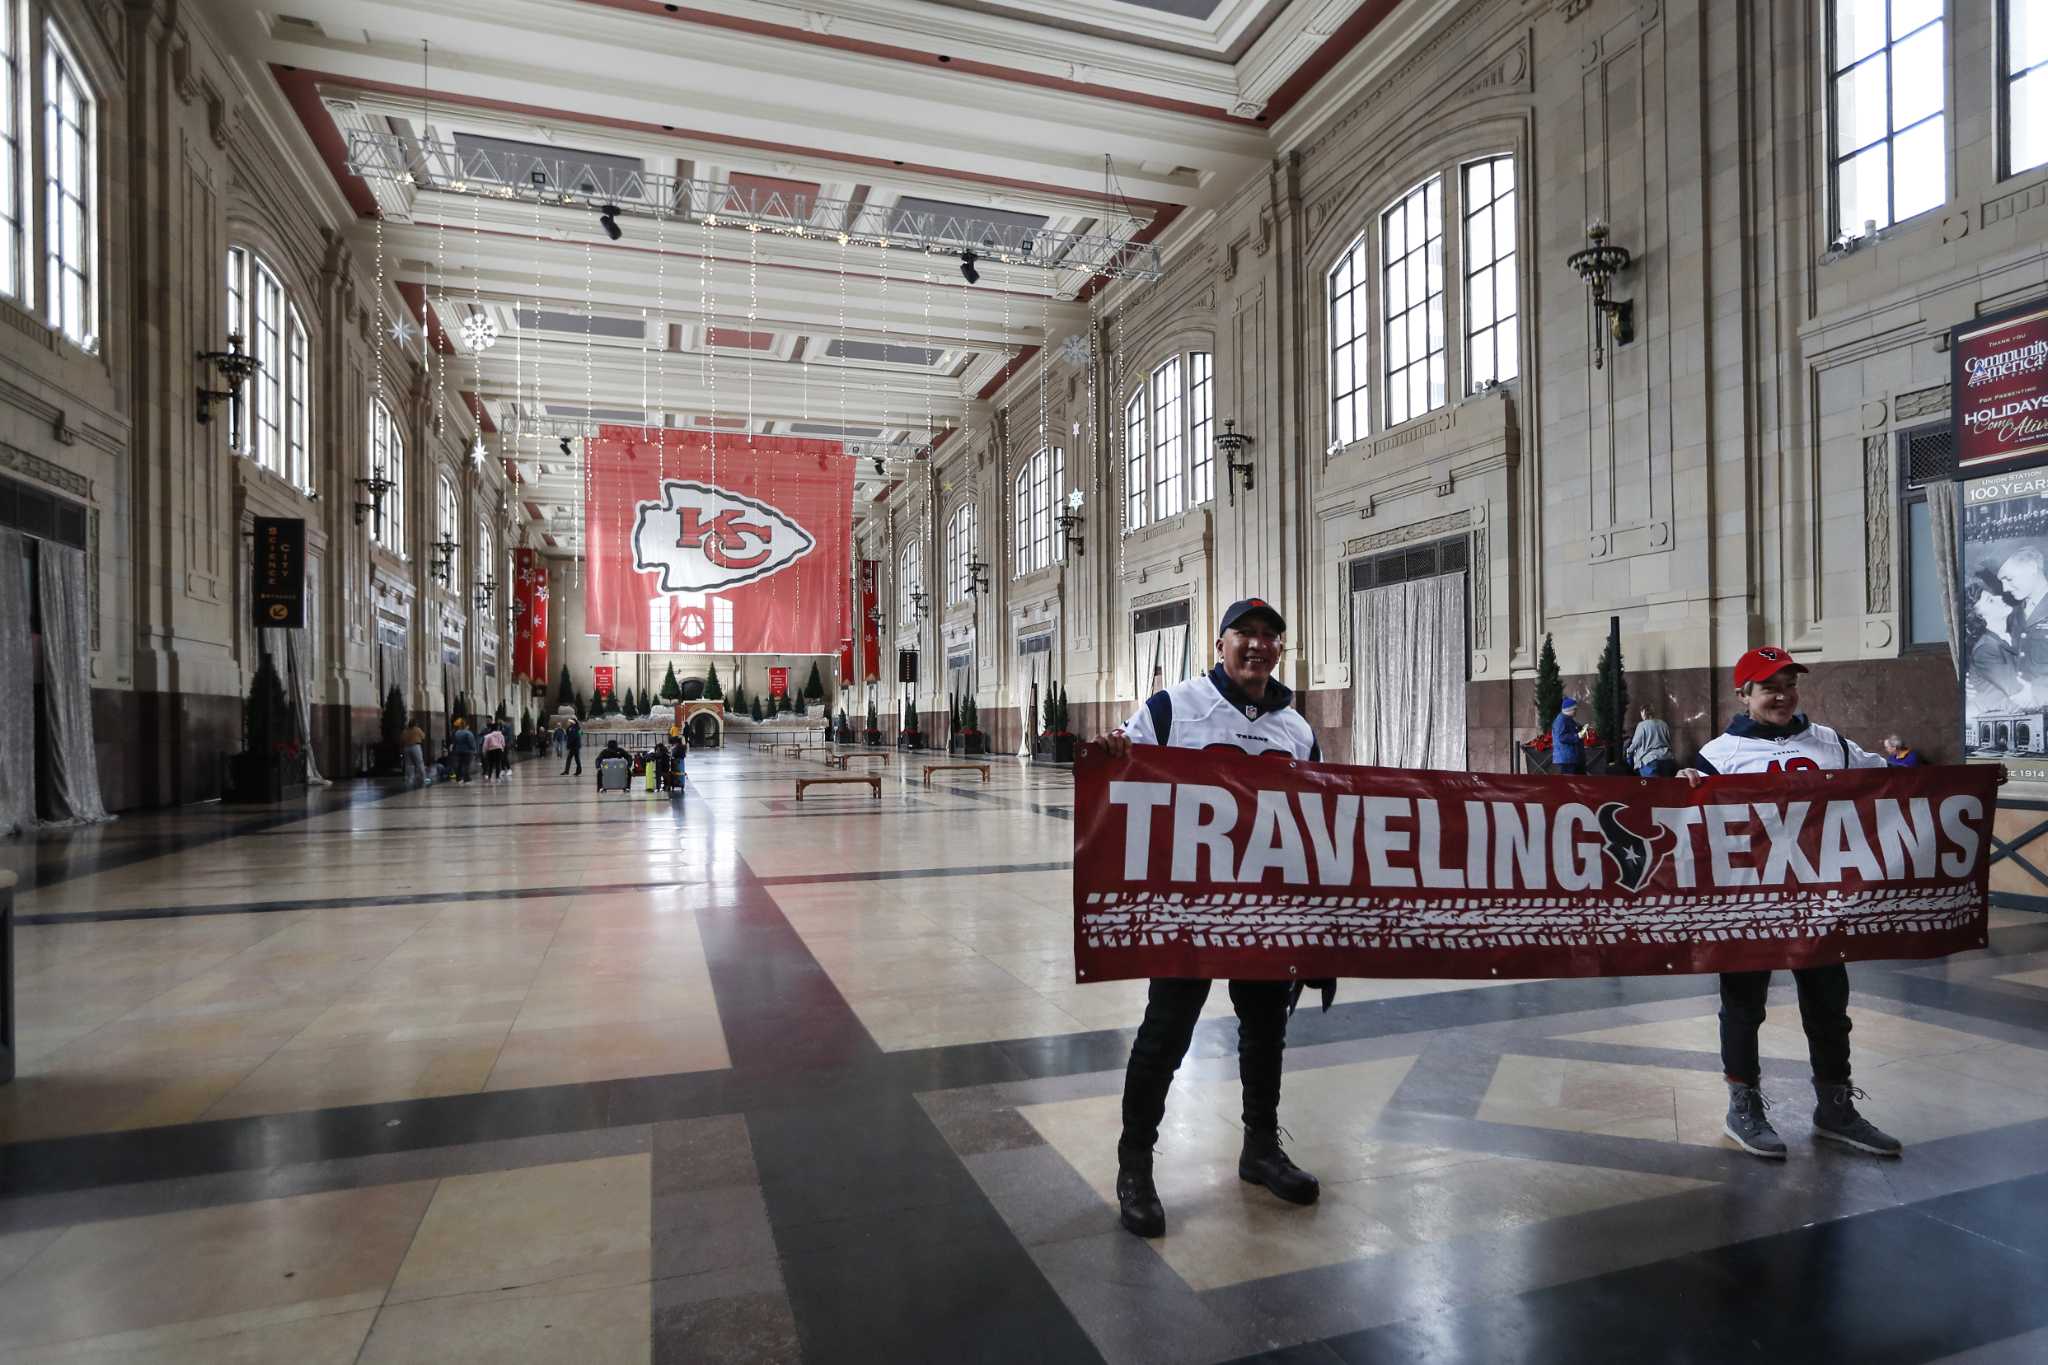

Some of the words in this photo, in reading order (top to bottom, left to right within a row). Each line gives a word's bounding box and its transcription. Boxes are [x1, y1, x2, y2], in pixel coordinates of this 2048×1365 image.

[1964, 340, 2048, 374] Community
[1964, 394, 2048, 426] HOLIDAYS
[2008, 470, 2042, 481] STATION
[1970, 486, 1999, 501] 100
[676, 507, 772, 569] KC
[280, 544, 290, 577] CITY
[1236, 733, 1269, 742] TEXANS
[1109, 781, 1602, 892] TRAVELING
[1651, 794, 1983, 889] TEXANS
